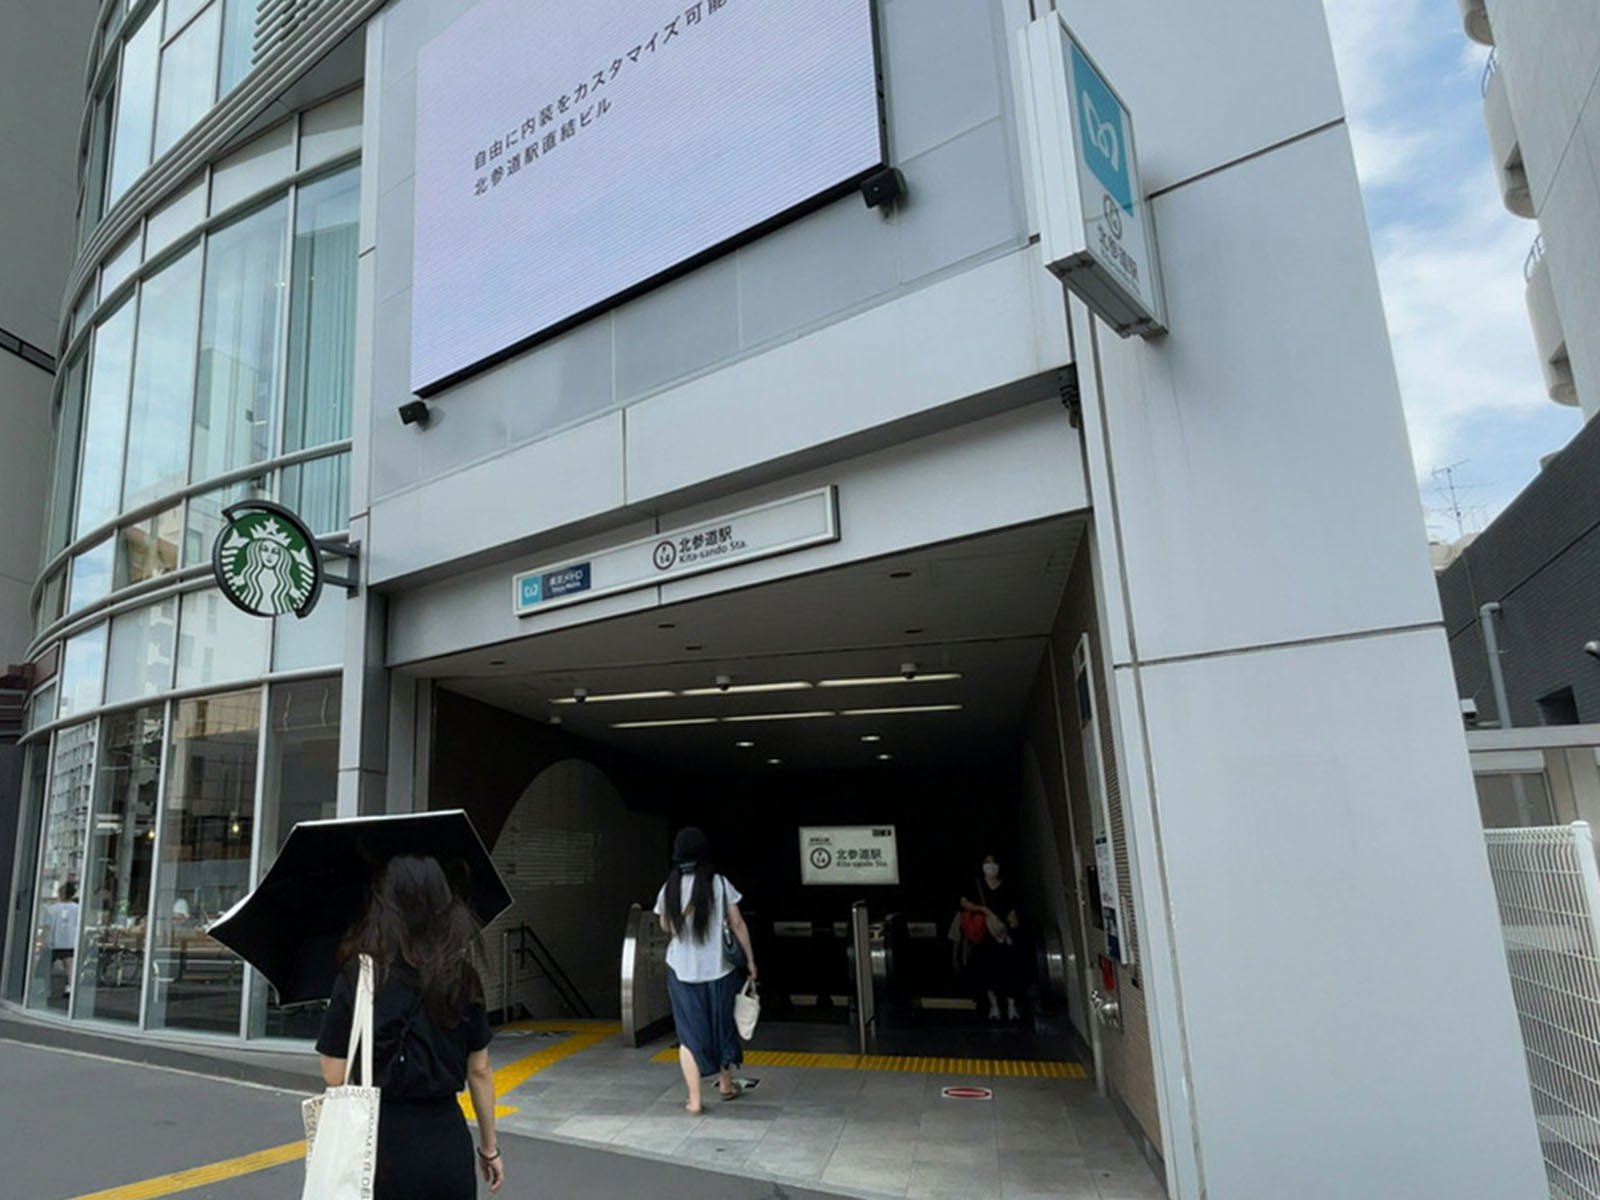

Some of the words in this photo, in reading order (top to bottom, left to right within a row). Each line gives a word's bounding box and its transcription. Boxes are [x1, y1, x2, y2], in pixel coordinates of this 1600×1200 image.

[473, 97, 613, 197] 北参道駅直結ビル
[678, 525, 733, 553] 北参道駅
[678, 545, 728, 563] Kita-sando
[729, 540, 748, 552] Sta.
